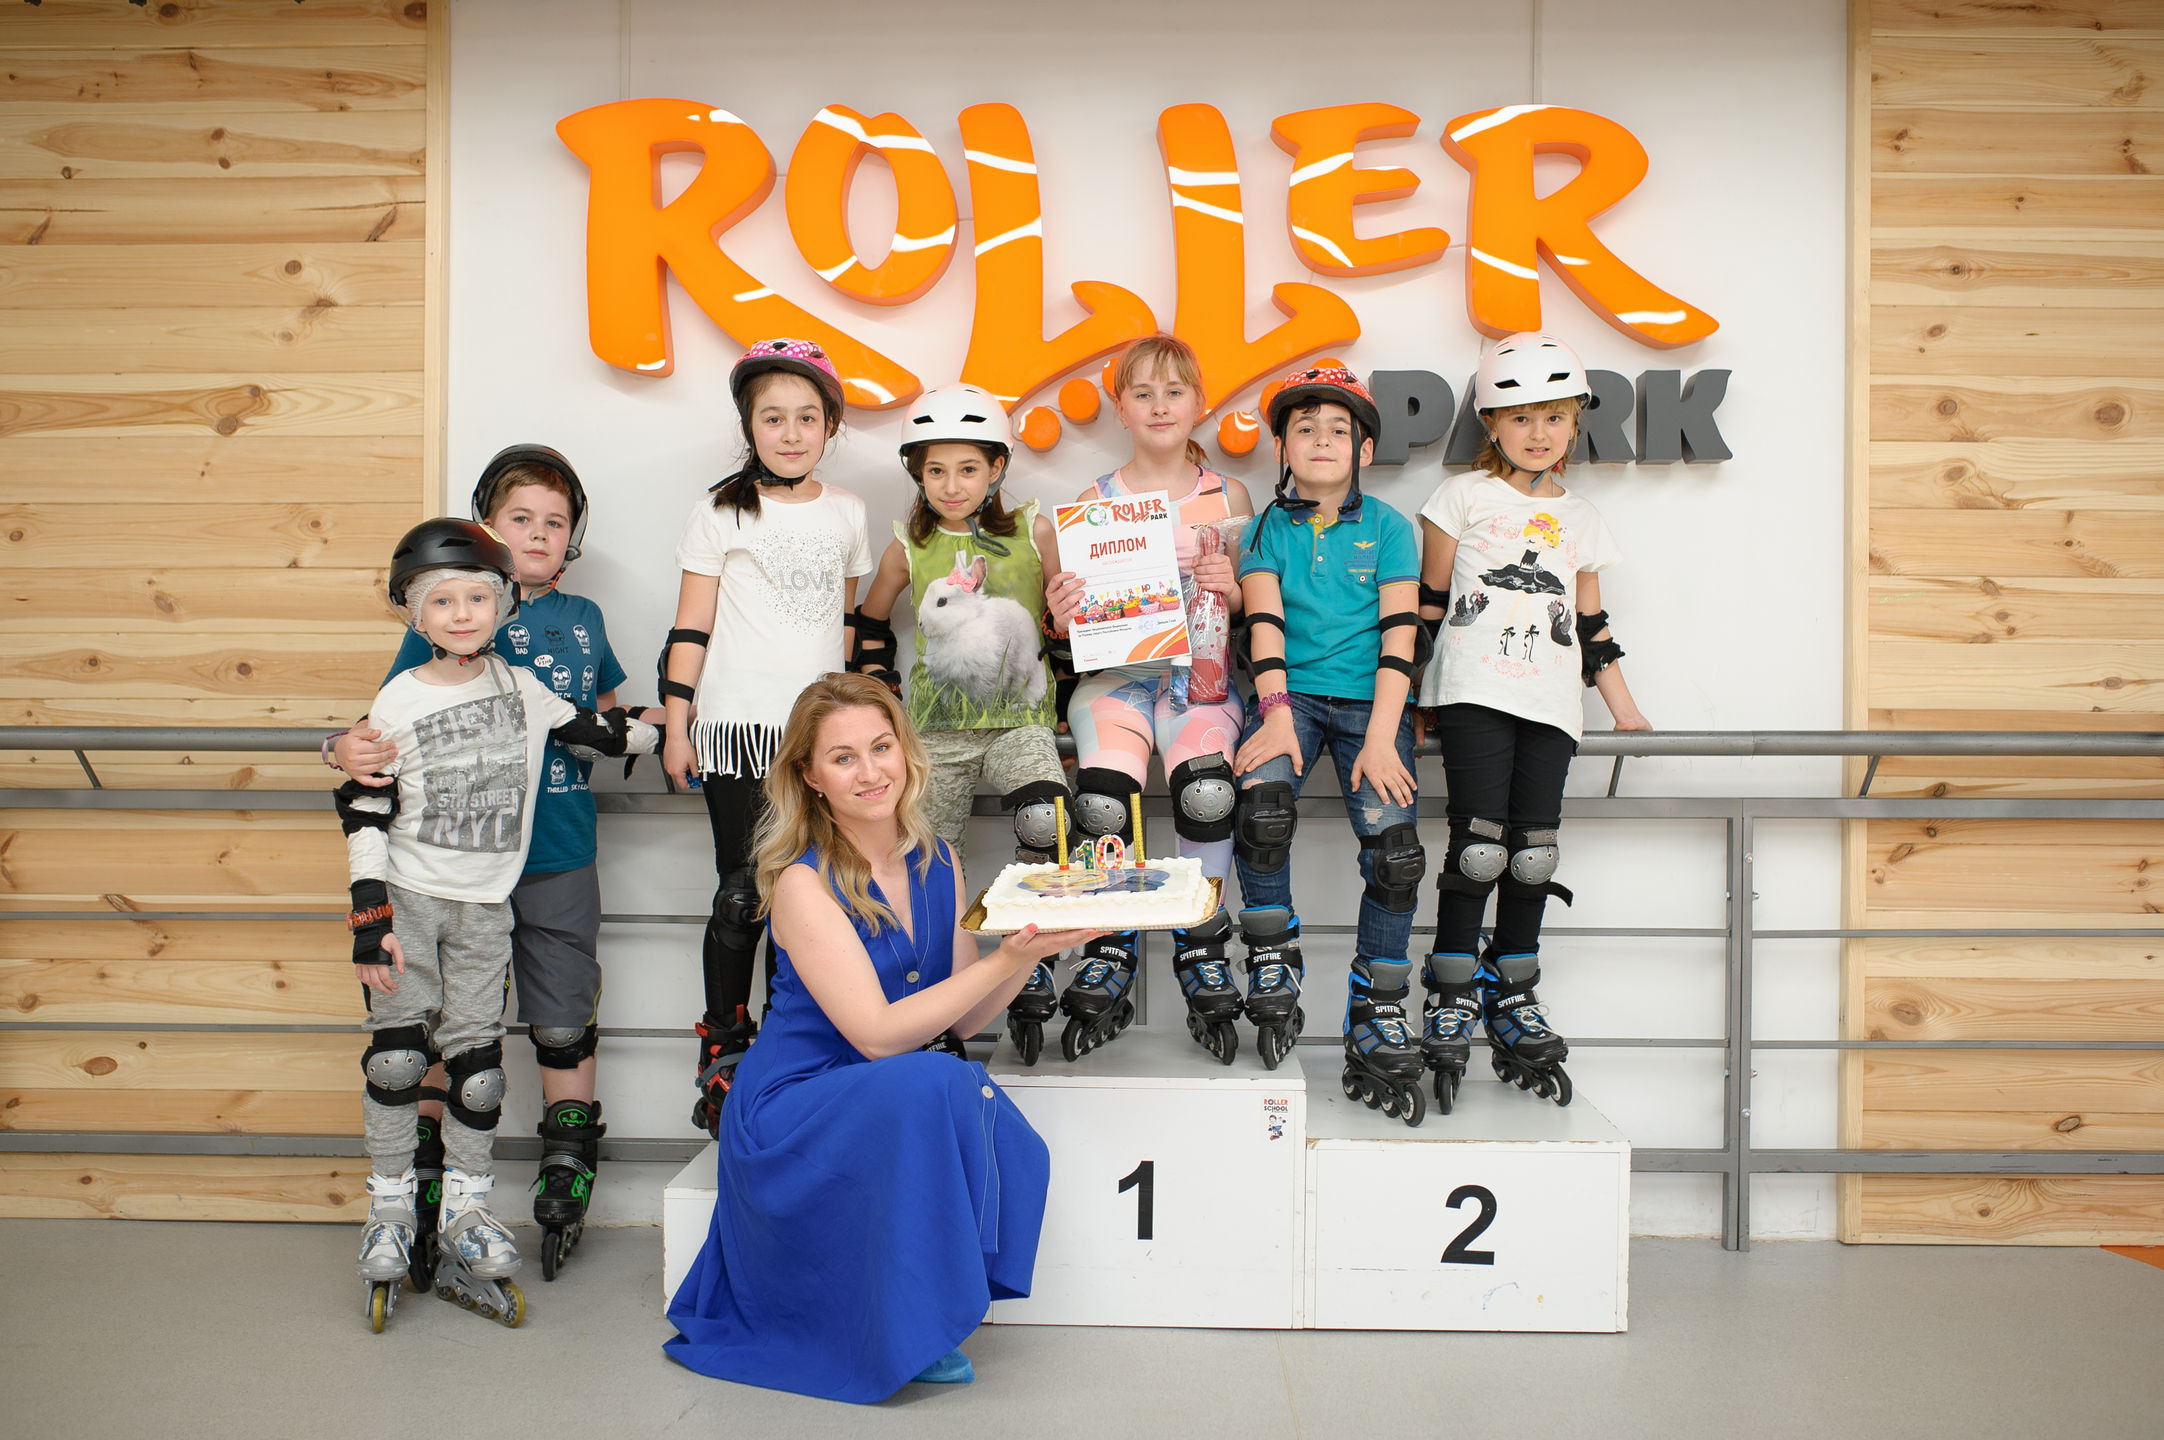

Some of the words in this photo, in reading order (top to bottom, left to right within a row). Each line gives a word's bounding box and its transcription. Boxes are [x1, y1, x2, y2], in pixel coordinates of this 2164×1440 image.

[556, 97, 1720, 420] ROLLER
[1111, 499, 1166, 523] ROLLER
[1150, 513, 1168, 521] PARK
[1090, 536, 1147, 560] ДИПЛОМ
[779, 569, 835, 592] LOVE
[515, 647, 528, 655] BAD
[431, 699, 518, 753] USA
[437, 793, 469, 809] 5TH
[470, 788, 519, 810] STREET
[433, 806, 519, 849] NYC
[1076, 834, 1126, 871] 10
[1100, 946, 1128, 960] SPITFIRE
[1180, 947, 1208, 962] SPITFIRE
[1253, 952, 1282, 964] SPITFIRE
[1375, 1004, 1401, 1015] SPITFIRE
[1456, 997, 1479, 1011] SPITFIRE
[1498, 993, 1527, 1009] SPITFIRE
[1263, 1098, 1289, 1106] ROLLER
[1118, 1160, 1155, 1240] 1
[1440, 1184, 1498, 1266] 2
